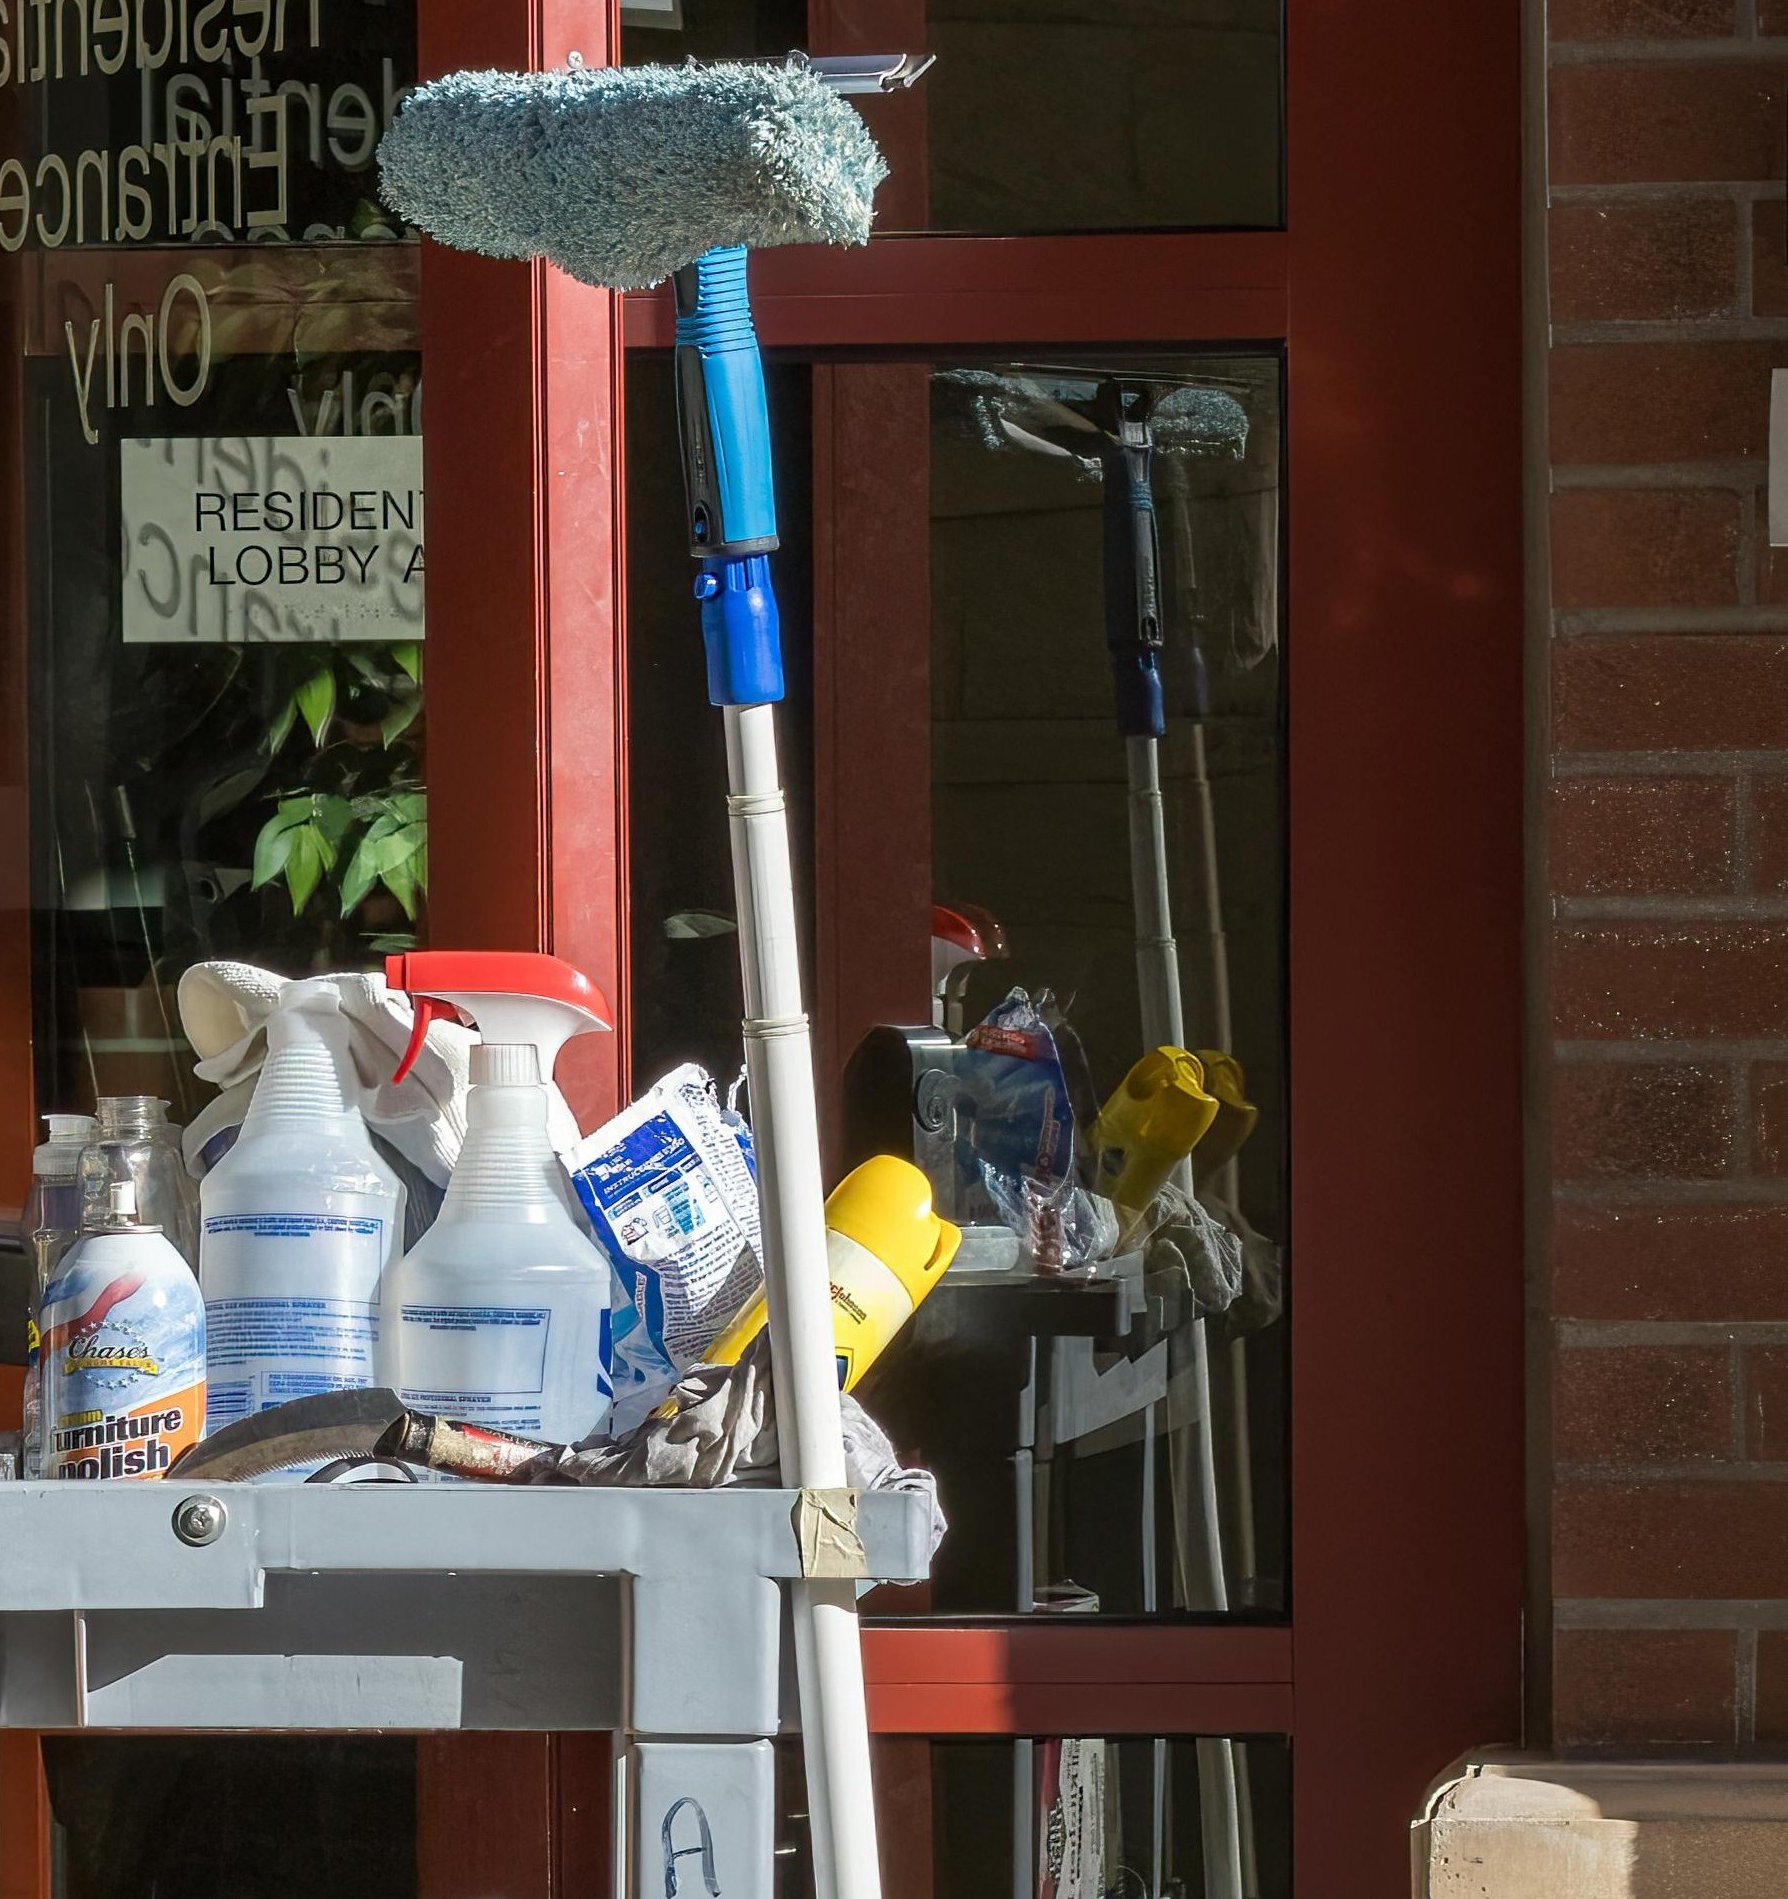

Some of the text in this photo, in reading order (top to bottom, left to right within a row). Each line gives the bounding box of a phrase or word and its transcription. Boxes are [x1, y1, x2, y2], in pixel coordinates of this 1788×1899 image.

[194, 490, 425, 532] RESIDEN
[208, 544, 381, 586] LOBBY
[52, 1408, 182, 1453] urniture
